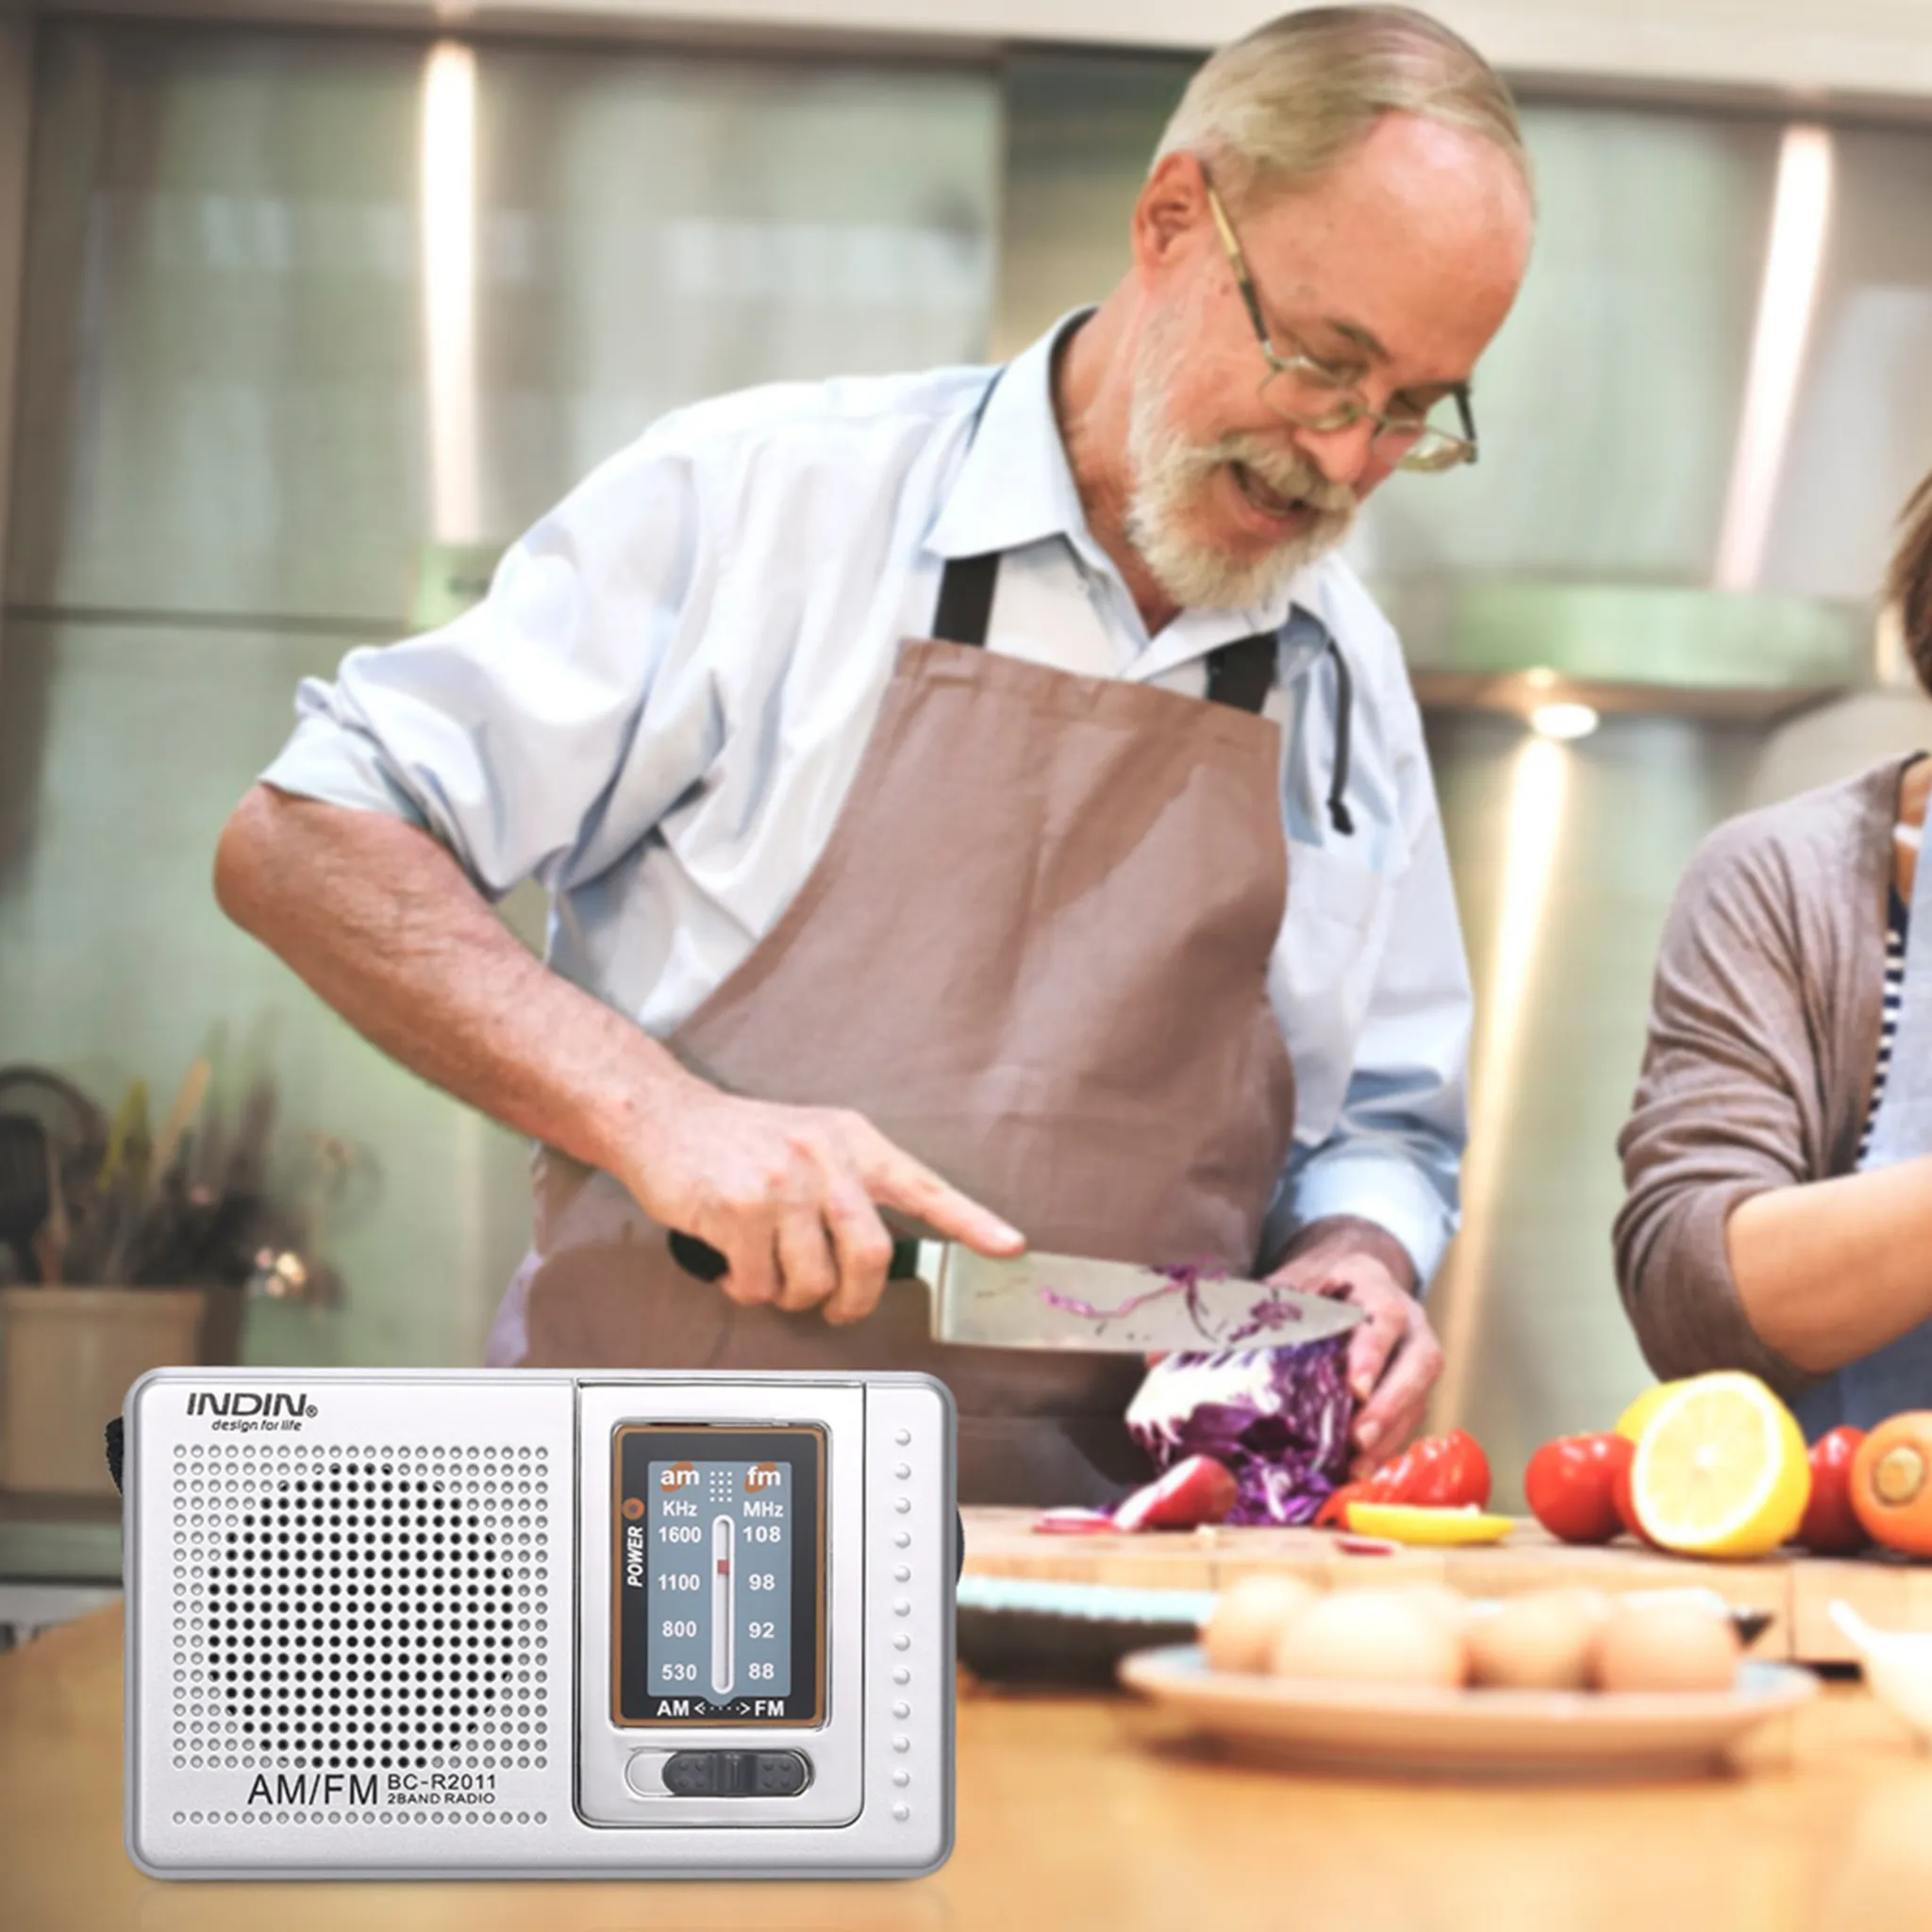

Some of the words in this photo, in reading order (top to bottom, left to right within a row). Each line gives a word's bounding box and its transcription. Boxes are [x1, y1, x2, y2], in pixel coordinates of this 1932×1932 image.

[211, 1420, 258, 1433] design
[260, 1420, 279, 1431] for
[281, 1420, 303, 1431] life
[659, 1469, 700, 1486] am
[746, 1465, 781, 1487] fm
[662, 1500, 698, 1518] KHz
[742, 1500, 784, 1518] MHz
[658, 1525, 702, 1543] 1600
[742, 1525, 781, 1543] 108
[626, 1525, 643, 1588] POWER
[658, 1574, 701, 1591] 1100
[748, 1574, 775, 1591] 98
[662, 1620, 698, 1638] 800
[748, 1622, 774, 1639] 92
[662, 1663, 698, 1681] 530
[748, 1662, 774, 1680] 88
[657, 1700, 690, 1718] AM
[755, 1700, 785, 1718] FM
[247, 1774, 377, 1806] AM/FM
[387, 1774, 495, 1790] BC-R2011
[387, 1792, 441, 1805] 2BAND
[444, 1792, 496, 1805] RADIO
